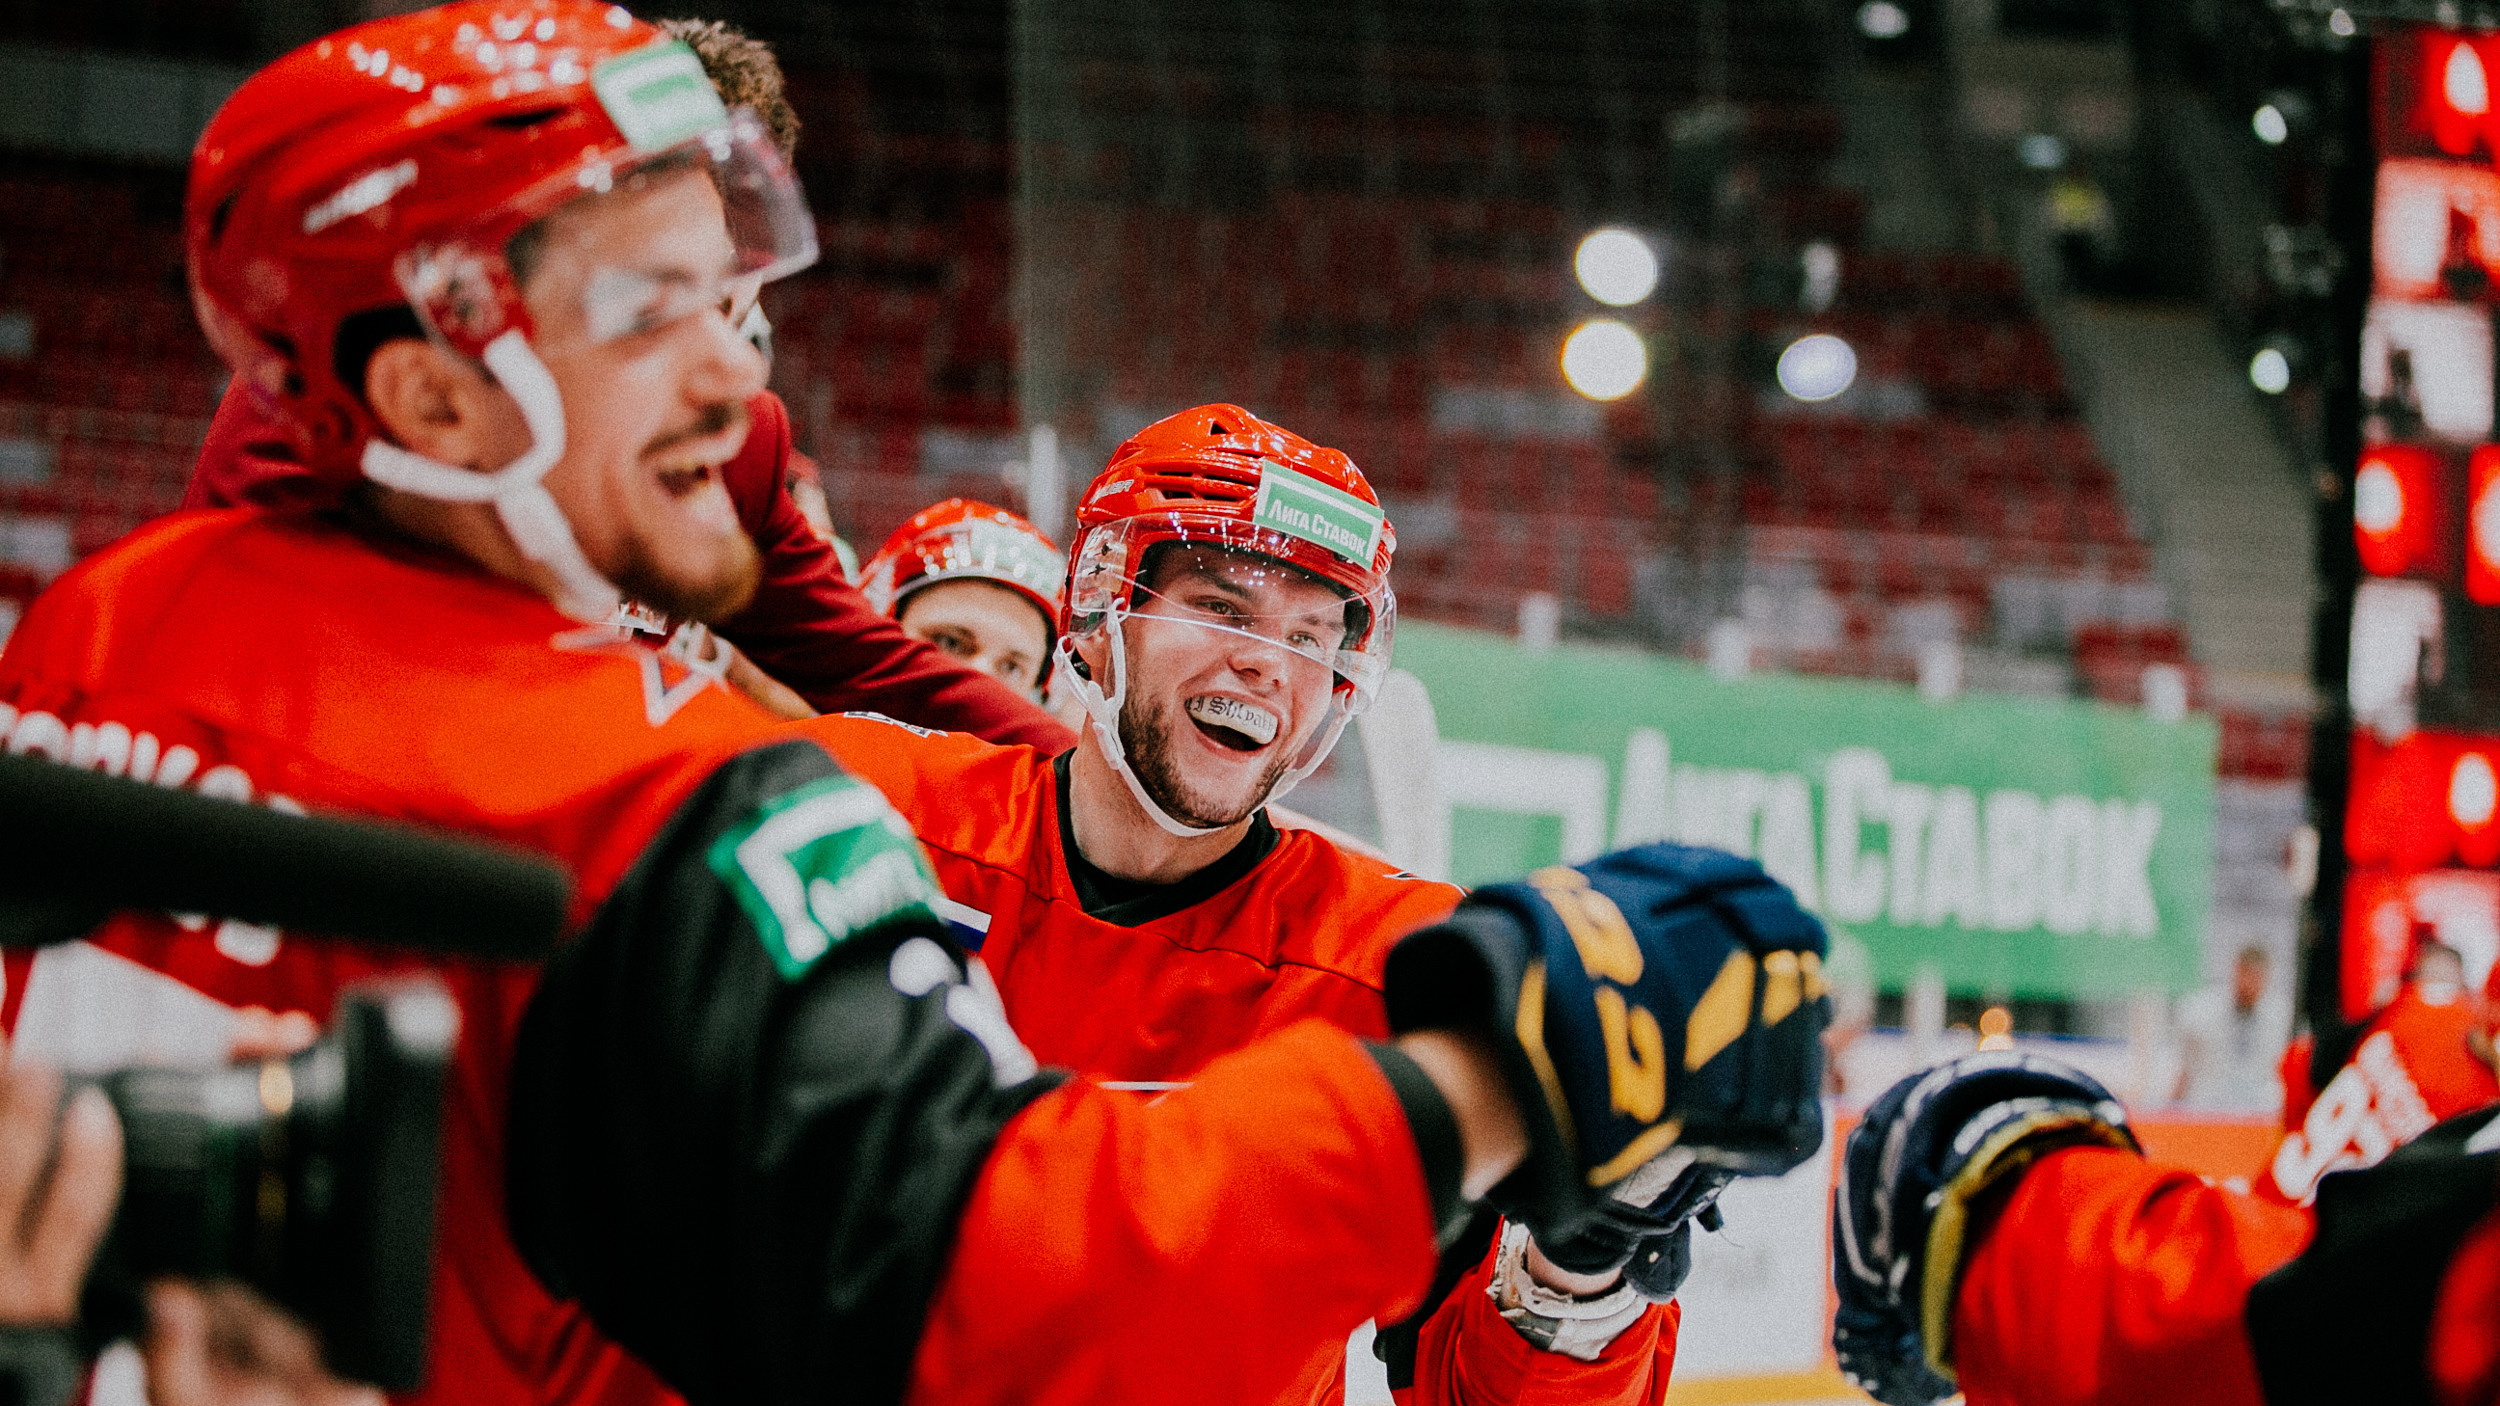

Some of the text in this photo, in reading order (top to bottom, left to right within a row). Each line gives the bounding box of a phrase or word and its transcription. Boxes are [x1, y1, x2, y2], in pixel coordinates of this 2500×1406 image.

[1267, 499, 1367, 557] ЛИГА СТАВОК
[1821, 747, 2162, 938] СТАВОК
